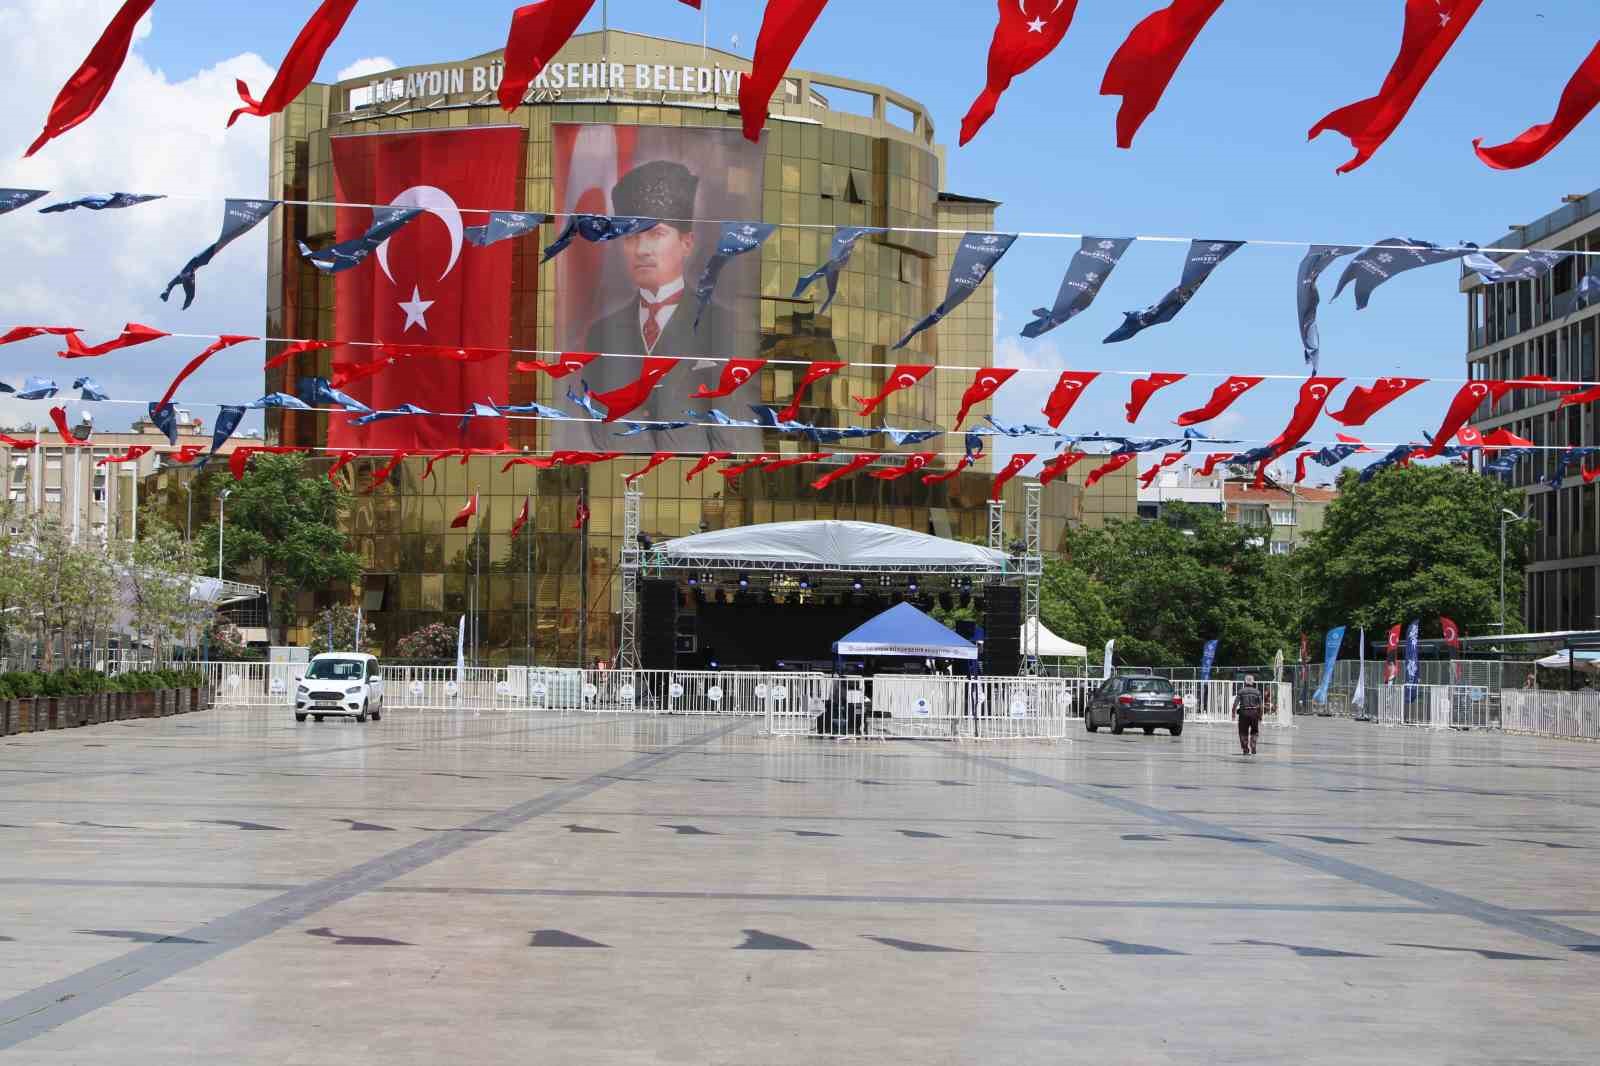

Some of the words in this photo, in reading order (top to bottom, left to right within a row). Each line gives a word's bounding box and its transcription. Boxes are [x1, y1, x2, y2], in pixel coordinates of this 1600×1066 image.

[405, 68, 464, 98] AYDIN
[472, 57, 625, 96] BÜKŞEHİR
[635, 62, 741, 96] BELEDİY
